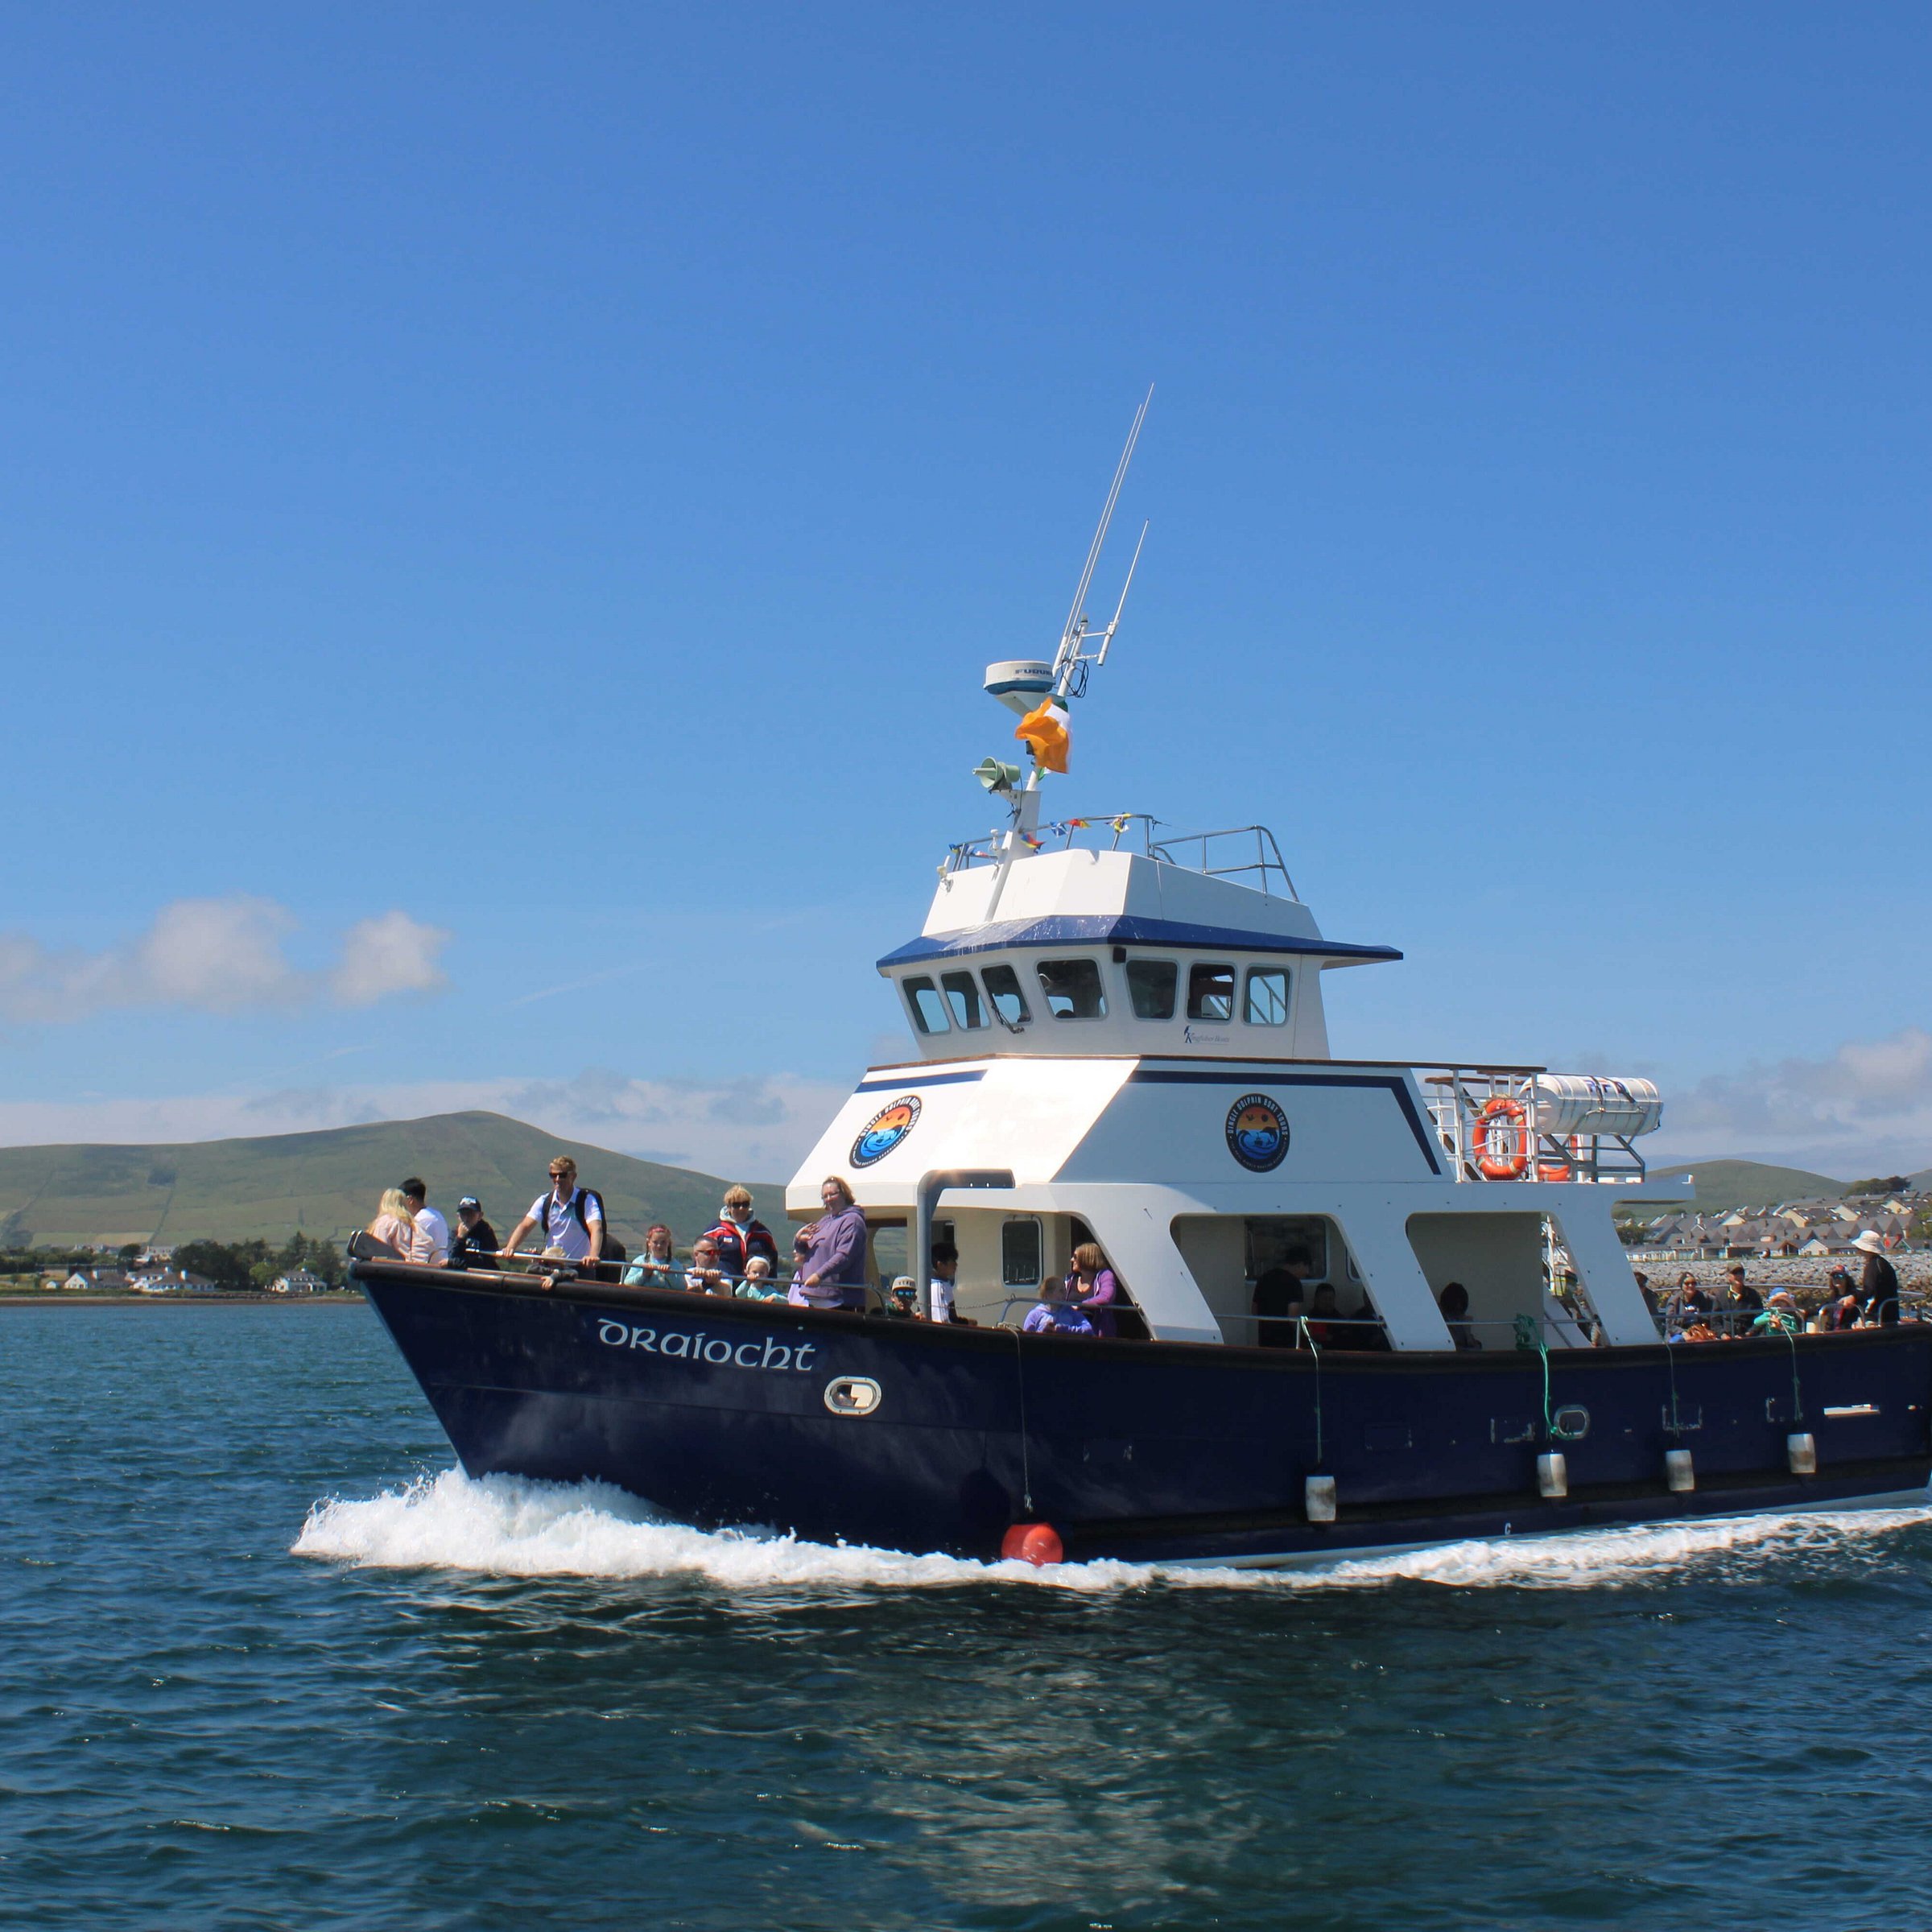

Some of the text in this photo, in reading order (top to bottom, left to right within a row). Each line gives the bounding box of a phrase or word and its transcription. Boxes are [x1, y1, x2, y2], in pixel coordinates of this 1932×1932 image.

[860, 1112, 882, 1137] DINGLE
[885, 1096, 911, 1113] DOLPHIN
[1228, 1096, 1288, 1135] DINGLE DOLPHIN BOAT TOURS
